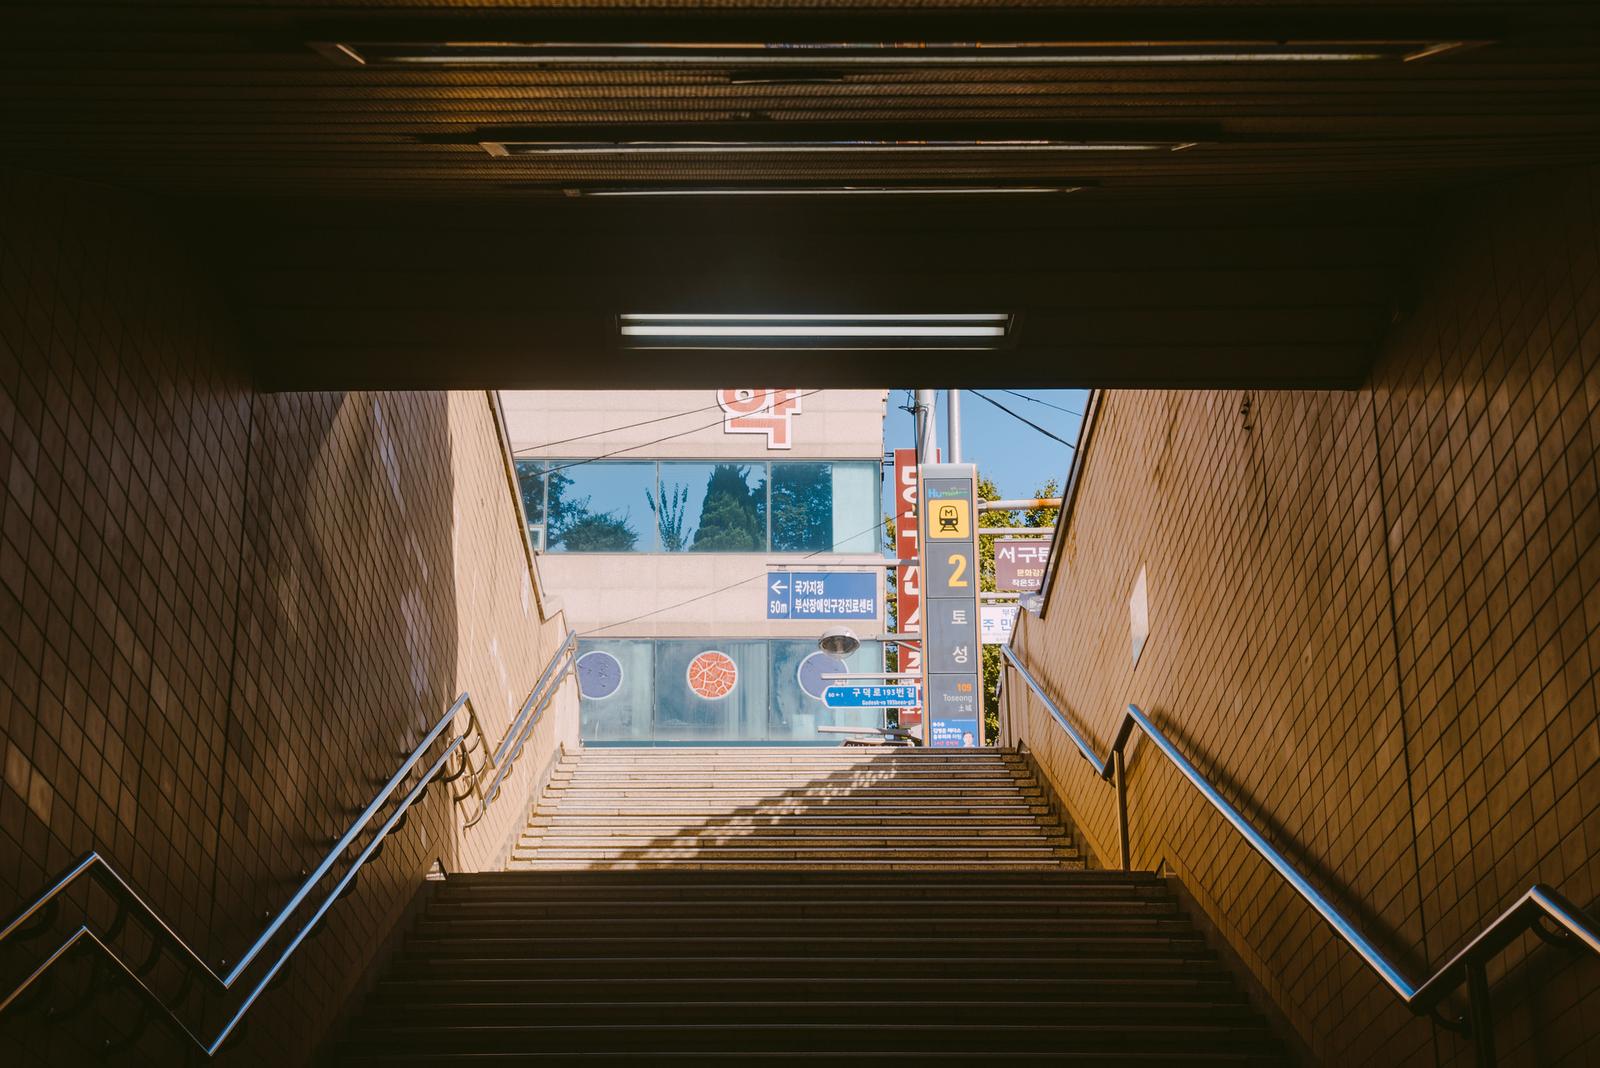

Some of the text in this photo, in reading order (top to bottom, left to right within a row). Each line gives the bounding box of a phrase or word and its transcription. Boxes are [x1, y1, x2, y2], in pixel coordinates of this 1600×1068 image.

[948, 553, 968, 587] 2
[795, 580, 824, 595] 국가지정
[770, 600, 788, 614] 50m
[795, 598, 874, 614] 부산장애인구강진료센터
[951, 609, 968, 664] 토성
[943, 693, 973, 703] Toseong
